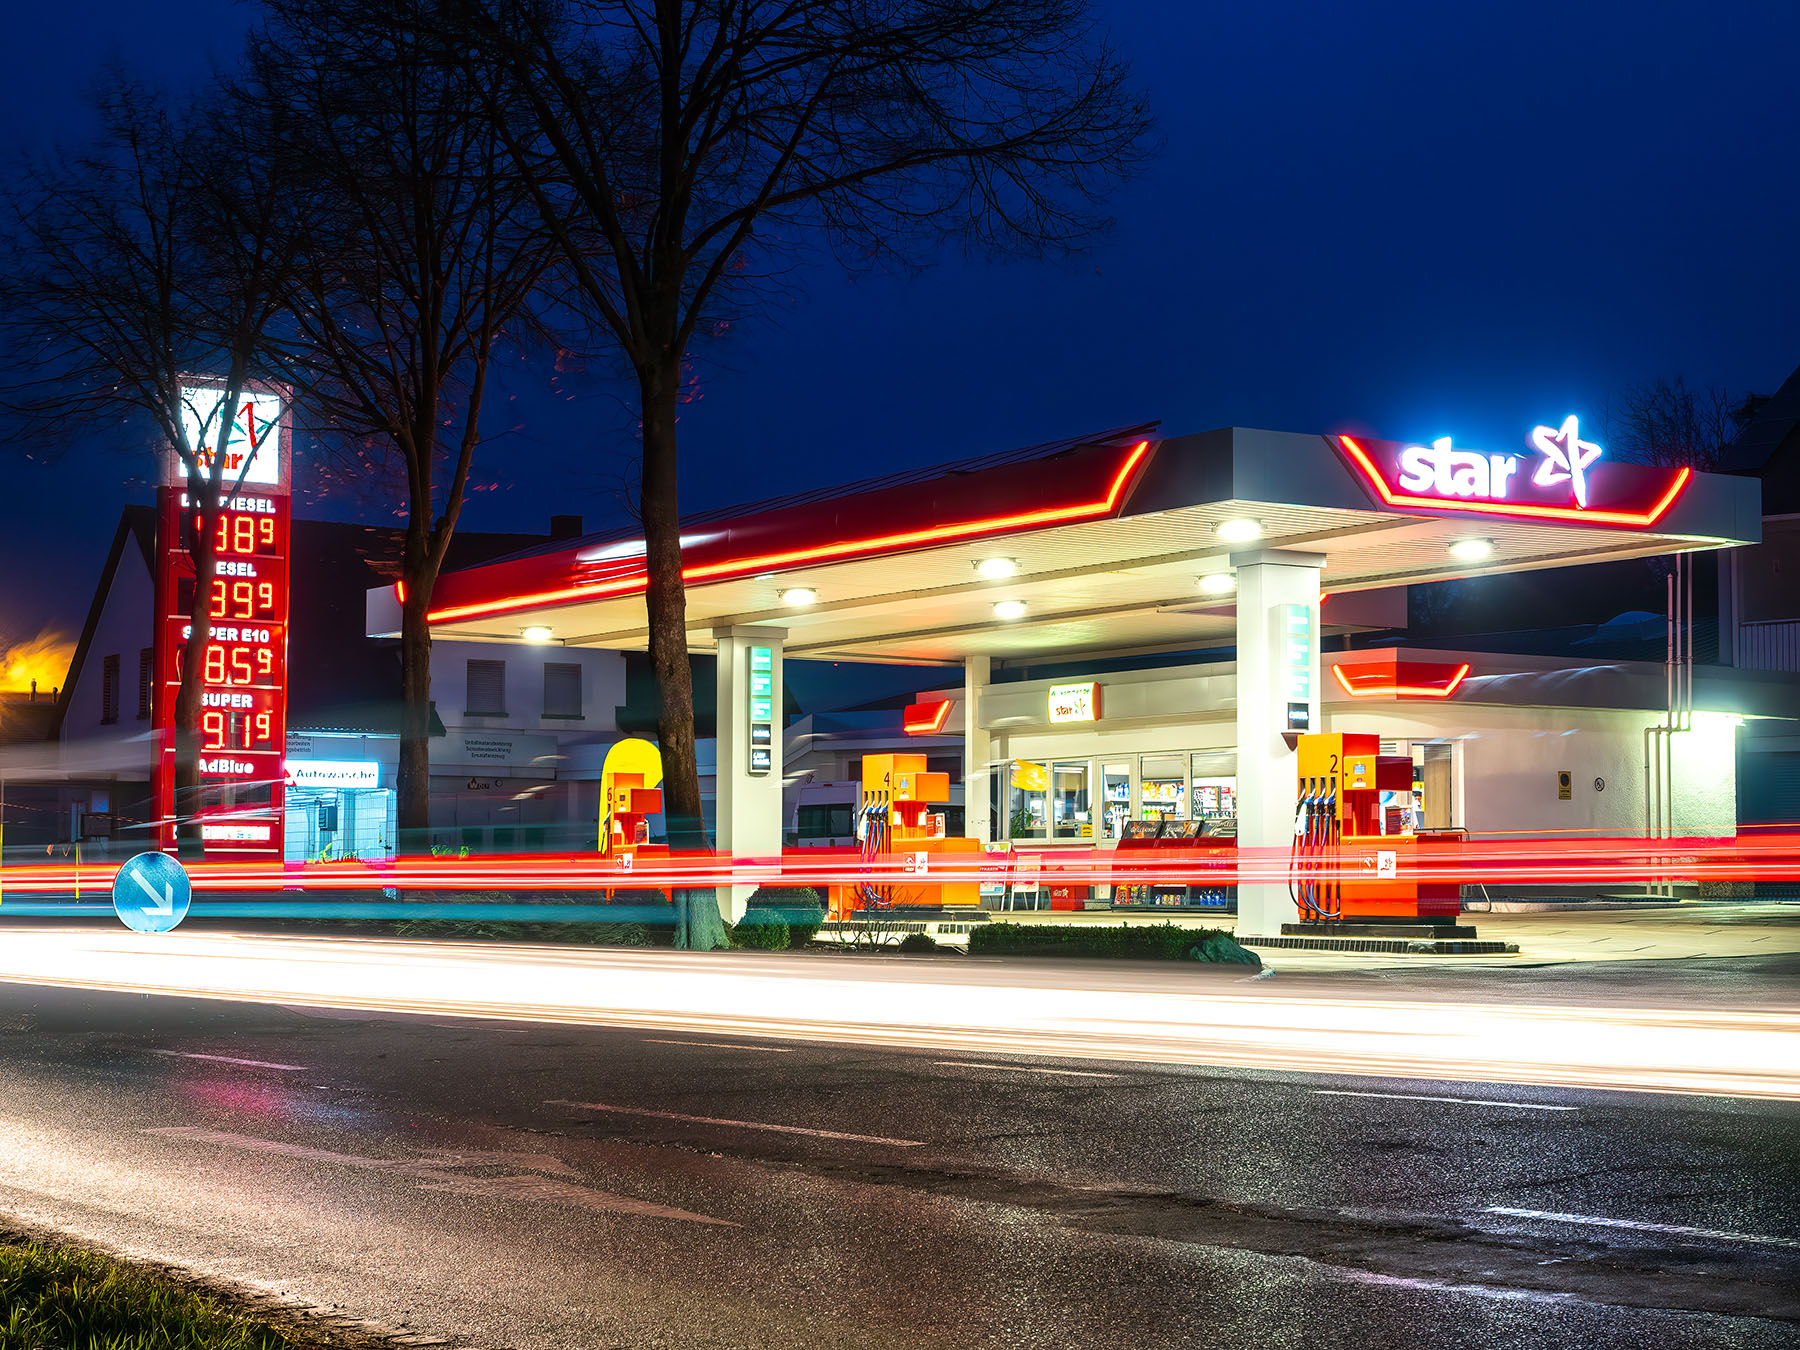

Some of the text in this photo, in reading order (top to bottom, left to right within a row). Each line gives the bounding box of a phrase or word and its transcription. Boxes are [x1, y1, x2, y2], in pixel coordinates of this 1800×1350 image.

[1399, 436, 1518, 498] star
[215, 561, 257, 577] ESEL
[182, 625, 270, 642] SPER E10
[199, 759, 254, 773] AdBlue
[1329, 754, 1339, 774] 2
[883, 771, 891, 787] 4
[607, 787, 613, 801] 6
